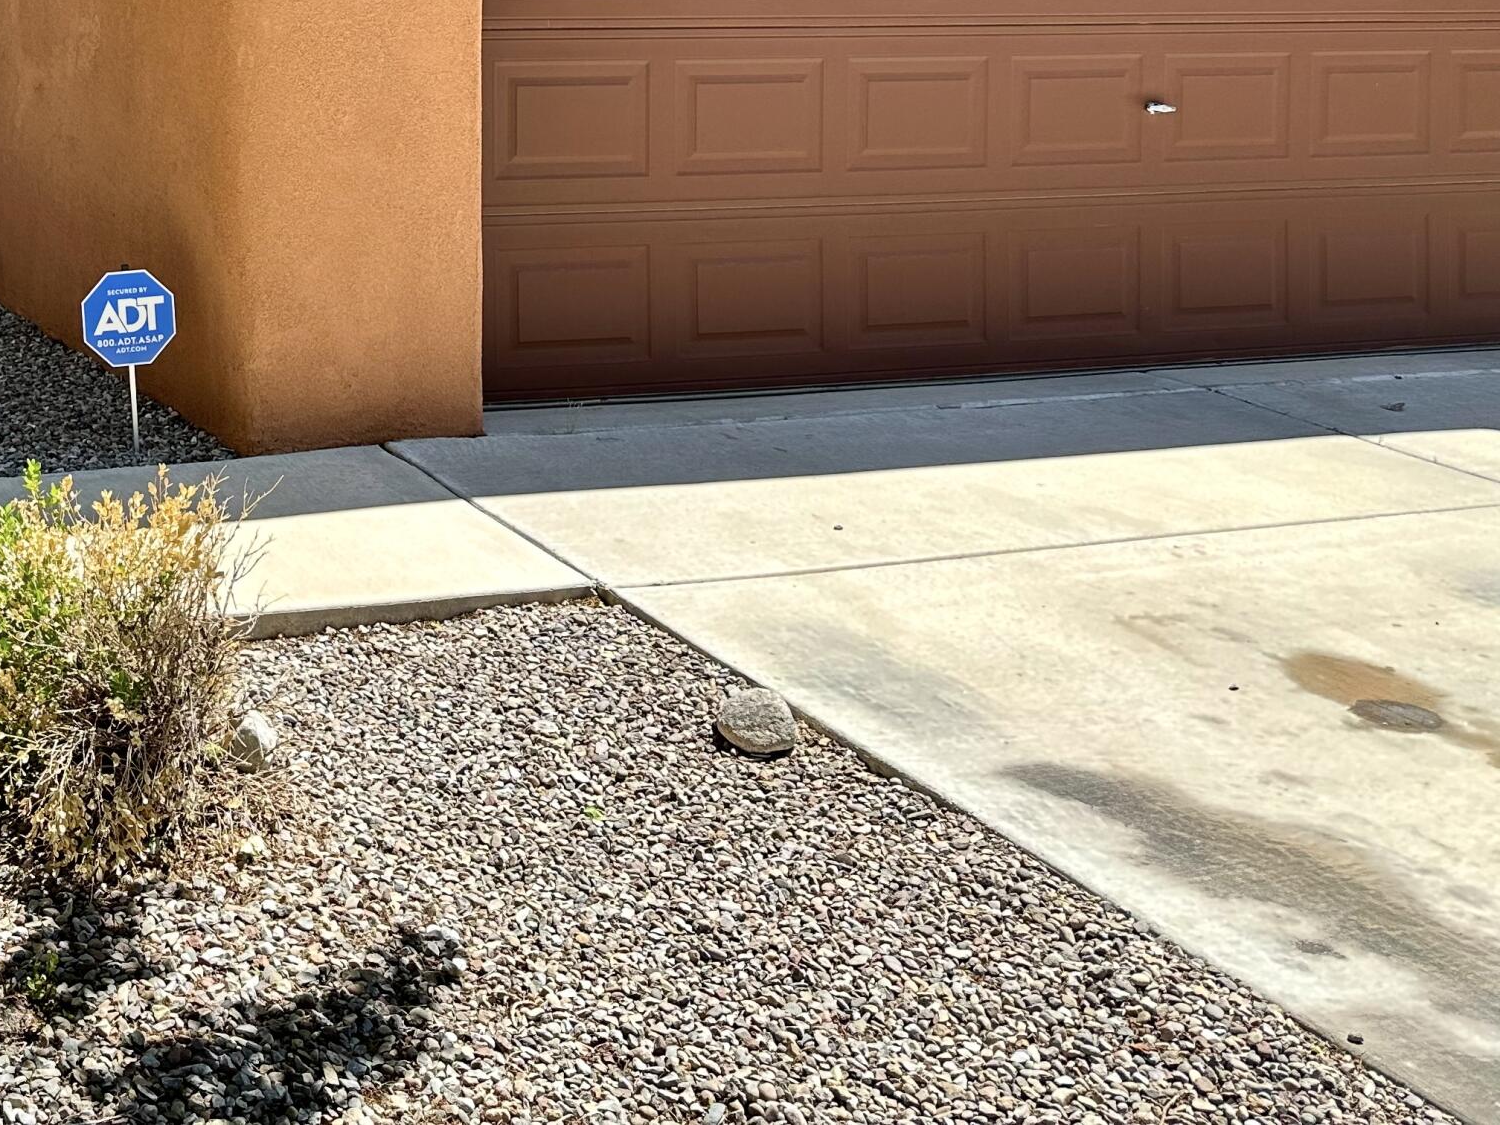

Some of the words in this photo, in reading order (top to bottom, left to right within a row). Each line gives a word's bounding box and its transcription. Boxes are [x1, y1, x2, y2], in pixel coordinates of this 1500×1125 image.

[107, 287, 137, 296] SECURED
[93, 295, 164, 336] ADT
[116, 345, 147, 354] ADT.COM
